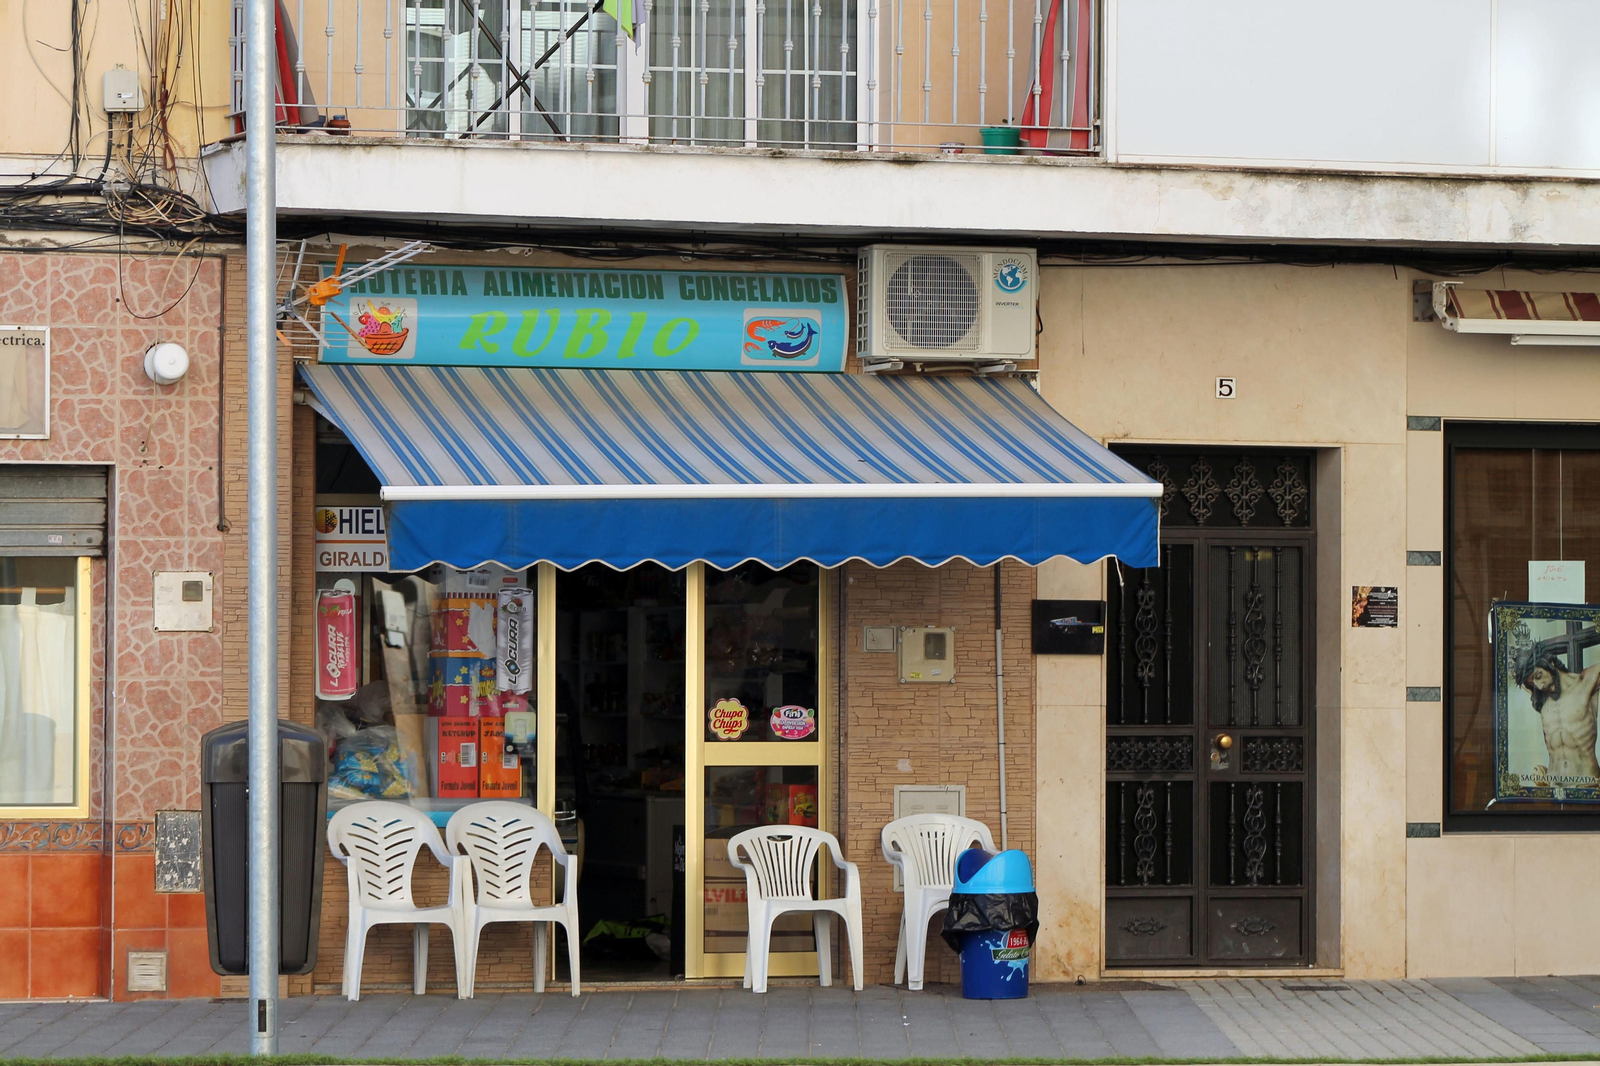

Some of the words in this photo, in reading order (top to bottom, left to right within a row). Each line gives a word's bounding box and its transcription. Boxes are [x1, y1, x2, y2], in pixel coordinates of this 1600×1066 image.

[336, 267, 468, 297] RUTERIA
[483, 271, 665, 300] ALIMENTACION
[678, 275, 838, 304] CONGELADOS
[0, 333, 45, 346] ctrica.
[458, 308, 700, 360] RUBIO
[1219, 378, 1233, 397] 5
[319, 550, 388, 567] GIRALD
[714, 708, 743, 720] Chupa
[712, 719, 743, 734] Chups
[1520, 773, 1558, 782] SAGRADA
[1560, 775, 1597, 783] LANZADA
[441, 781, 460, 791] Formato
[460, 781, 476, 791] Juvenil
[501, 781, 518, 791] Juvenil
